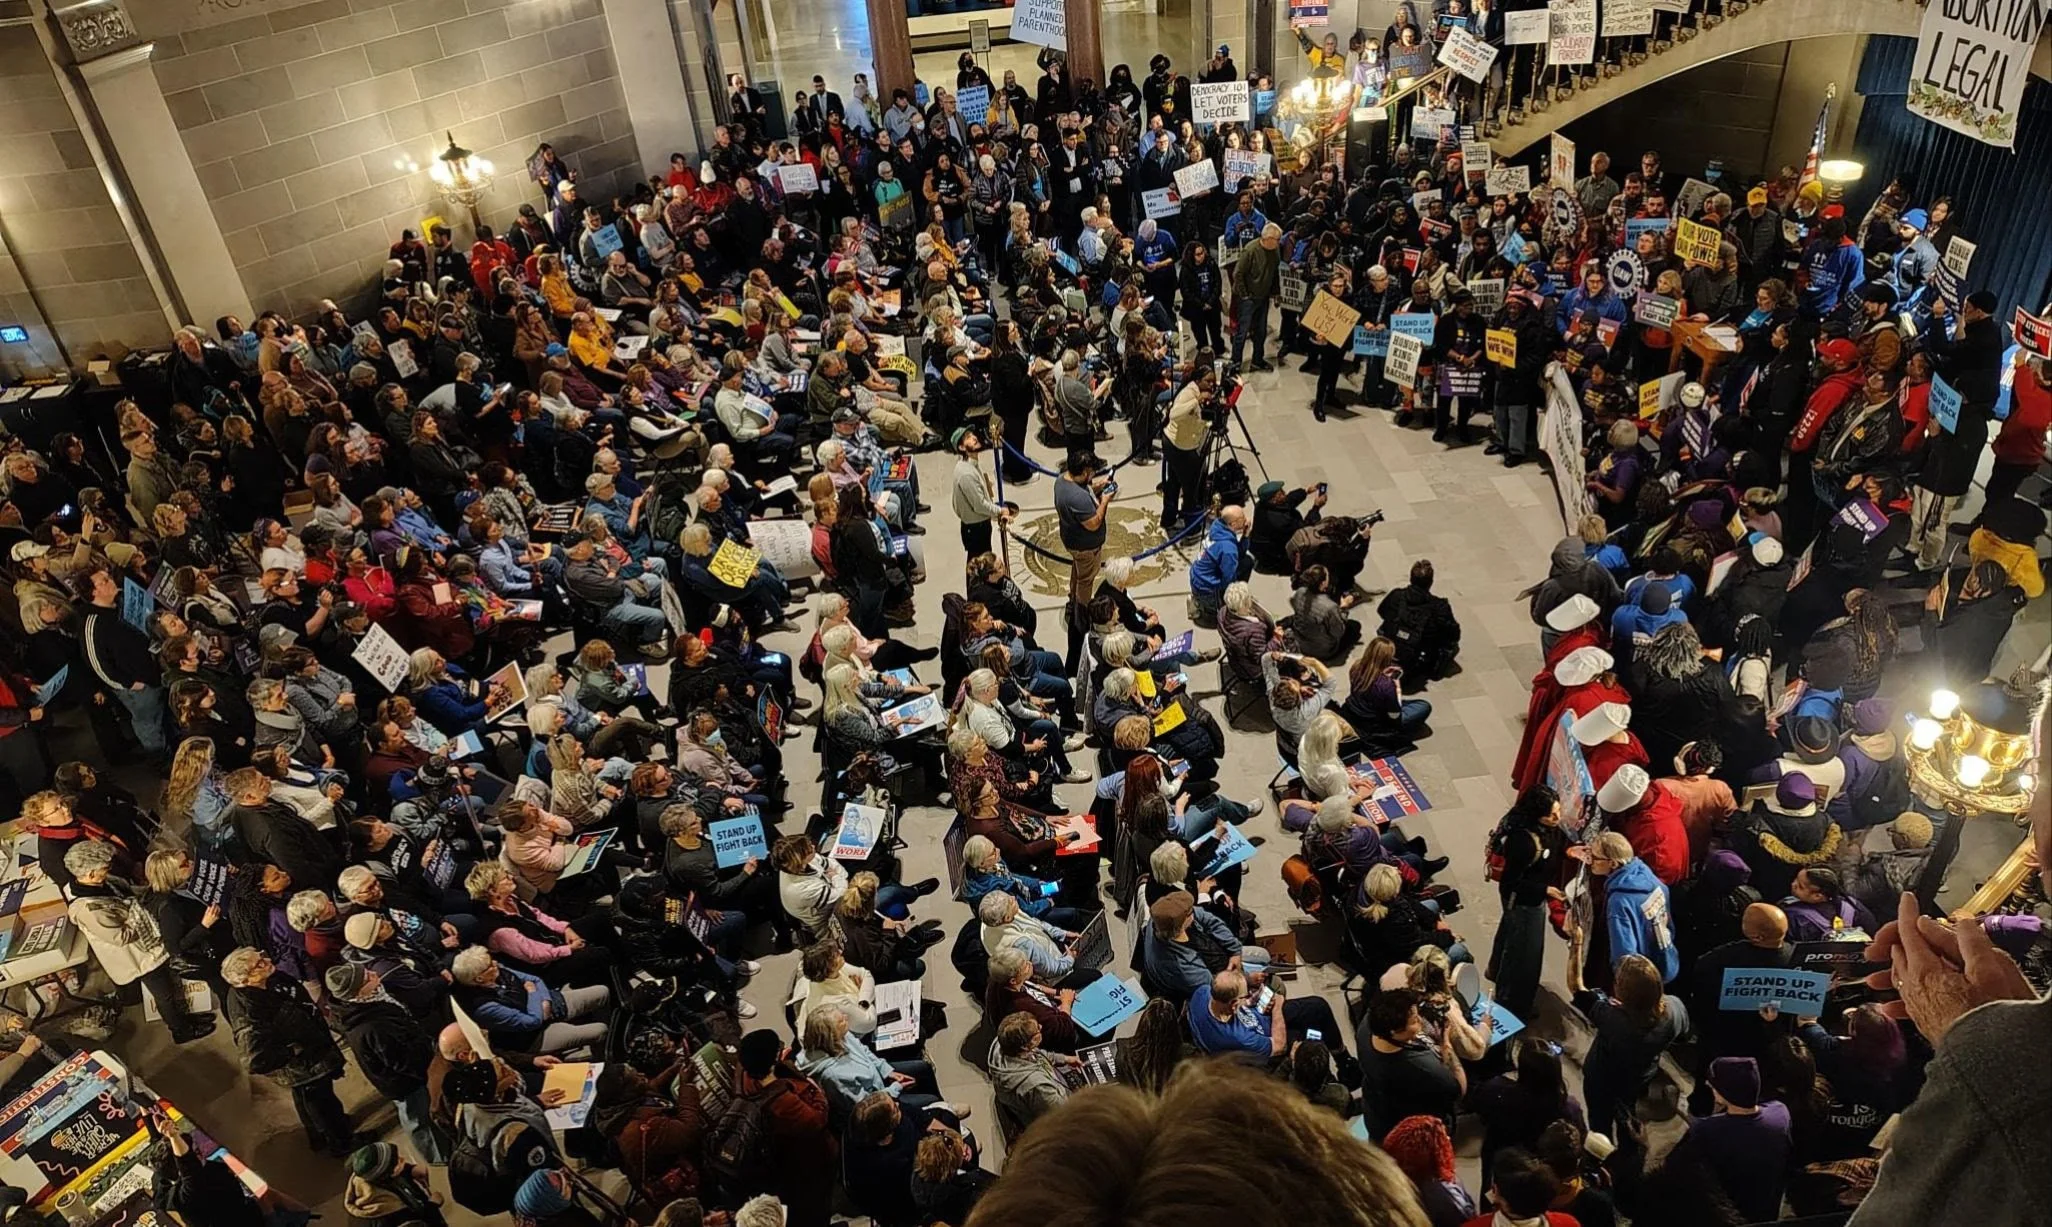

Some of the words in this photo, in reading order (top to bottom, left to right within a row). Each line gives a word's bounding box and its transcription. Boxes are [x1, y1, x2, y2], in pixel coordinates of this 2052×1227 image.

[1029, 8, 1063, 23] PLANNED
[1553, 13, 1571, 22] OUR
[1574, 12, 1592, 21] VOICE
[1019, 17, 1066, 36] PARENTHOO
[1553, 25, 1571, 34] OUR
[1573, 24, 1594, 33] POWER
[1452, 48, 1480, 66] RESPECT
[1923, 32, 2010, 113] LEGAL
[1192, 84, 1230, 96] DEMOCRACY
[1194, 96, 1213, 108] LET
[1216, 94, 1248, 105] VOTERS
[1203, 106, 1239, 119] DECIDE
[1226, 149, 1239, 160] LET
[1698, 226, 1719, 245] VOTE
[1471, 283, 1500, 294] HONOR
[1642, 311, 1658, 320] FIGHT
[1393, 335, 1419, 352] HONOR
[1488, 344, 1500, 352] WE
[1393, 359, 1408, 371] END
[1940, 402, 1957, 419] BACK
[1850, 502, 1869, 524] STAND
[1864, 520, 1876, 531] UP
[717, 827, 745, 840] STAND
[745, 824, 758, 835] UP
[716, 840, 741, 853] FIGHT
[742, 834, 764, 848] BACK
[835, 847, 867, 856] WORK
[193, 880, 203, 896] OUR
[202, 885, 213, 902] OUR
[1733, 976, 1787, 987] STAND
[1792, 980, 1816, 989] UP
[1724, 987, 1772, 997] FIGHT
[1774, 988, 1821, 1002] BACK
[73, 1113, 98, 1135] LIVE
